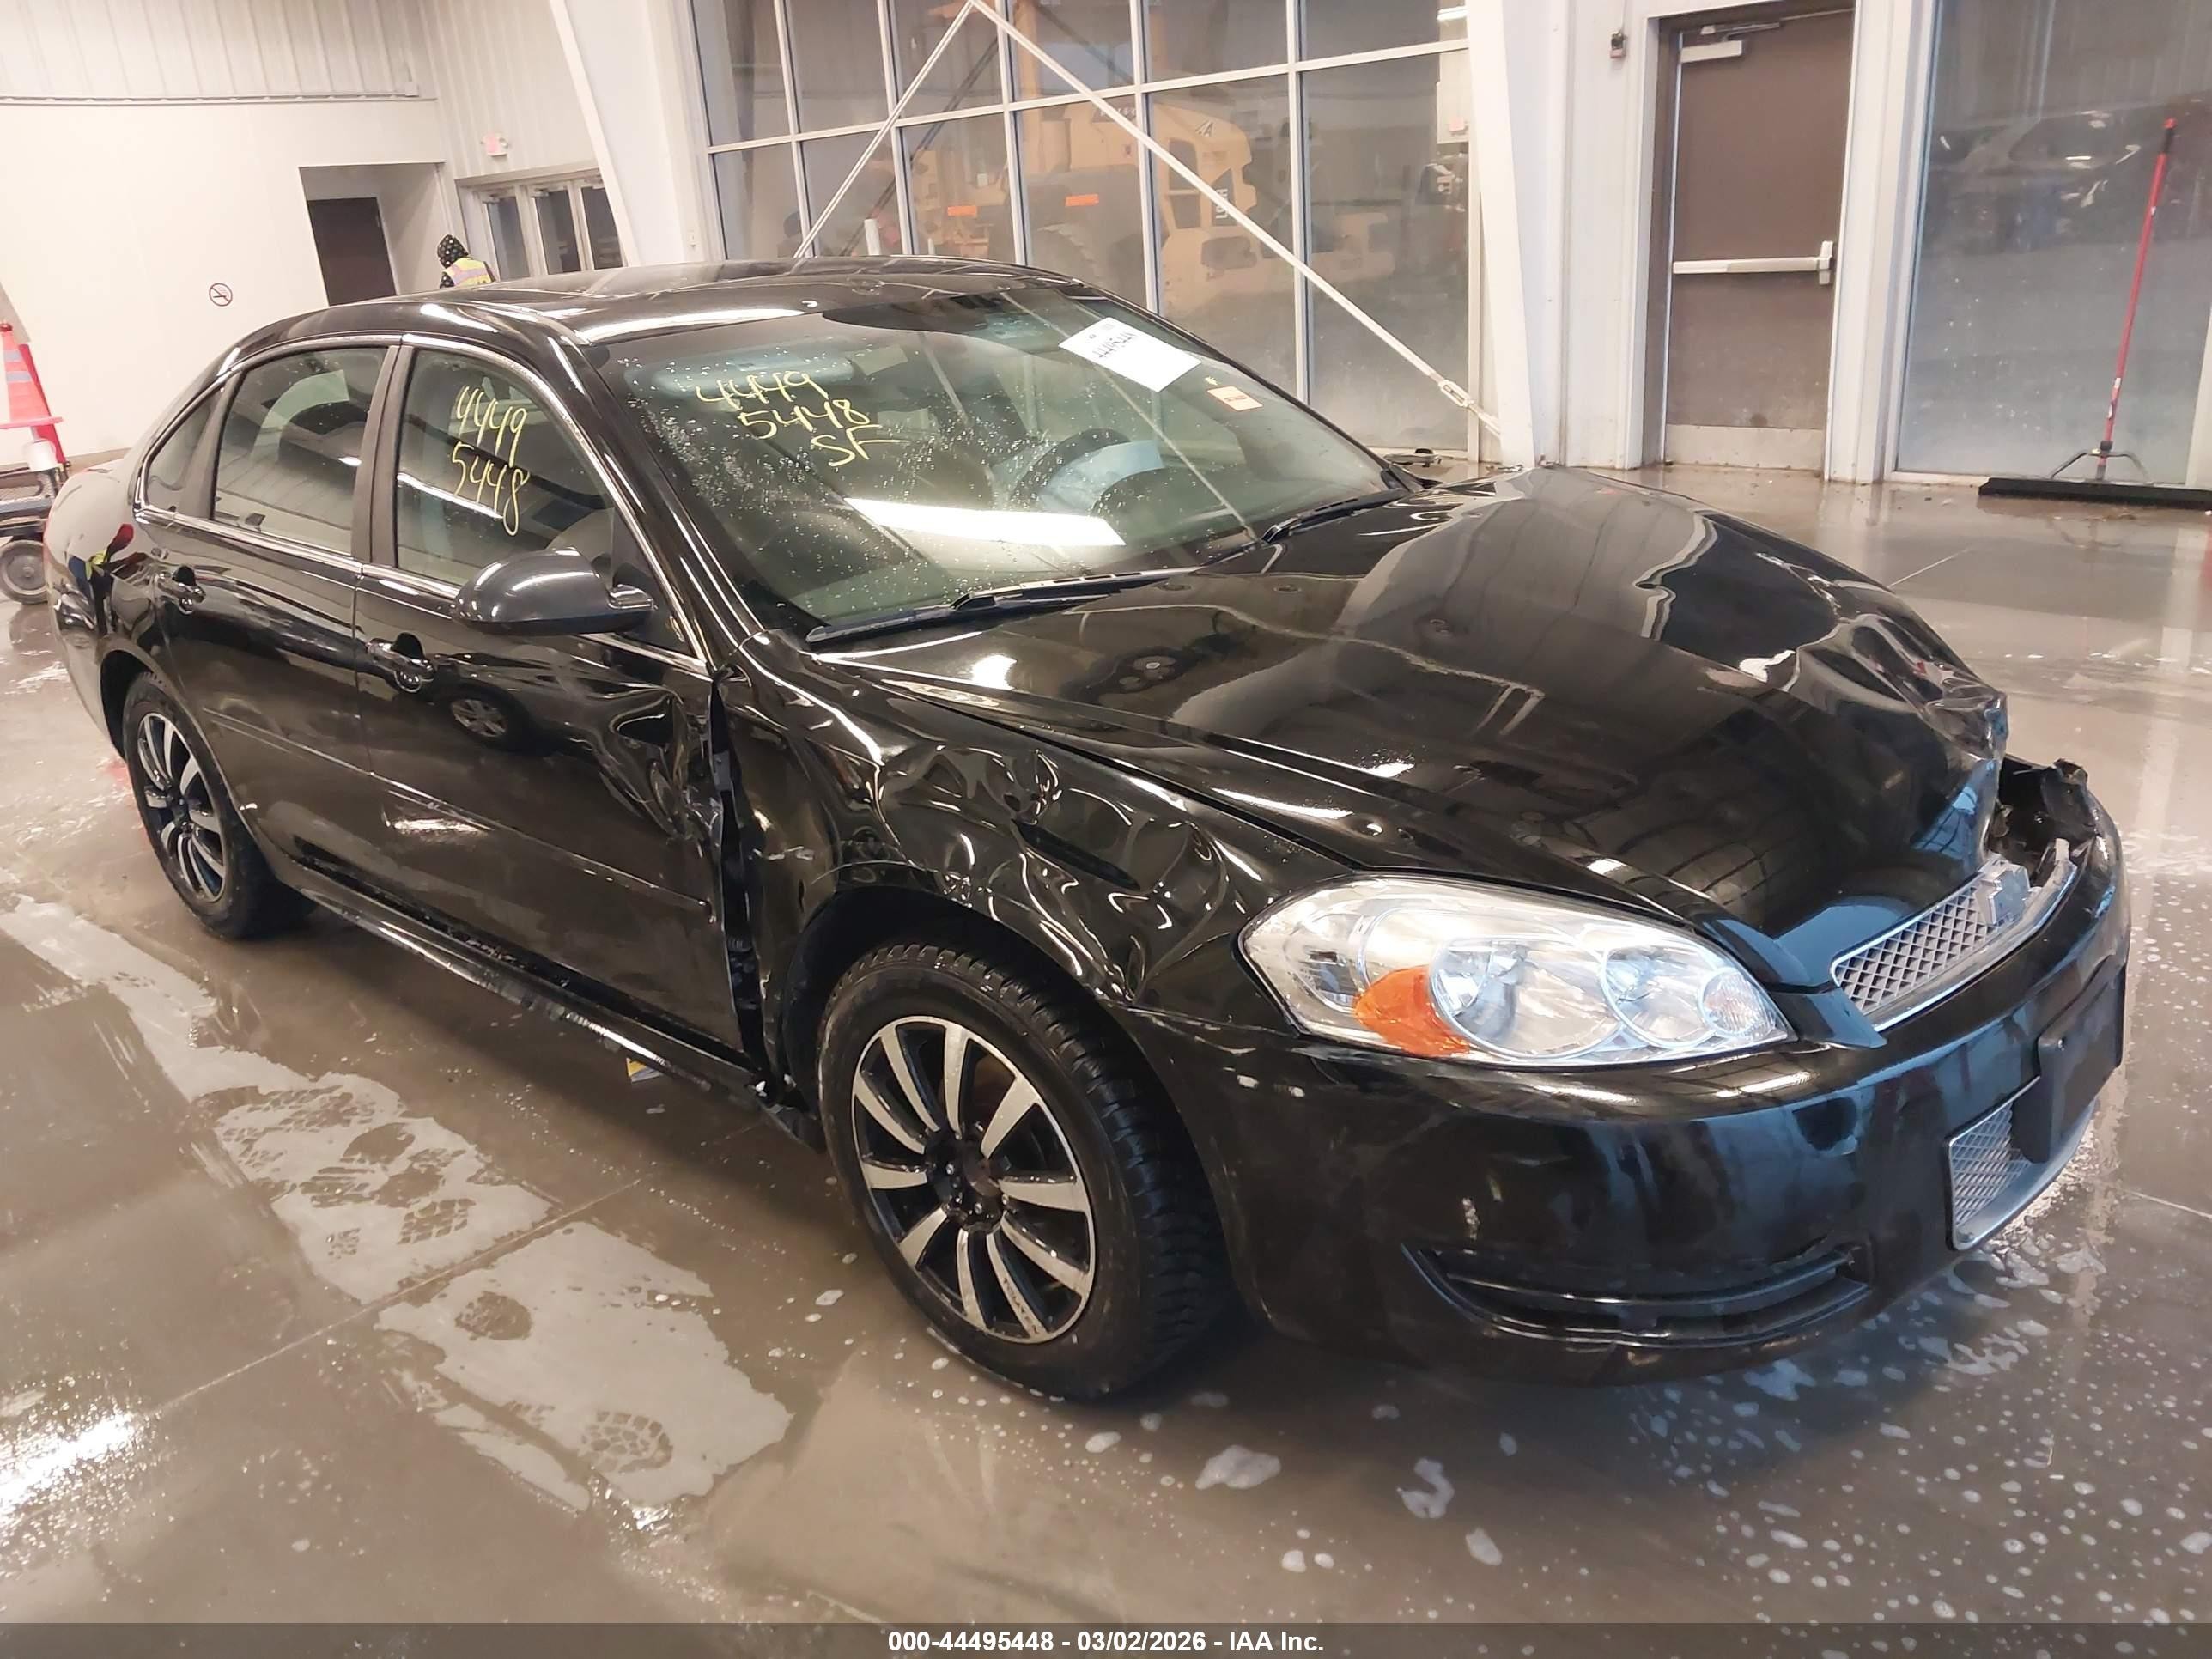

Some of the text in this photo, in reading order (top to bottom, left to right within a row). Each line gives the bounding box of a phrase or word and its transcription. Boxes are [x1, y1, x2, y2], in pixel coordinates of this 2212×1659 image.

[696, 371, 830, 410] 4449
[737, 399, 870, 439] 5448
[457, 386, 527, 468] 4449
[452, 441, 530, 536] 5448
